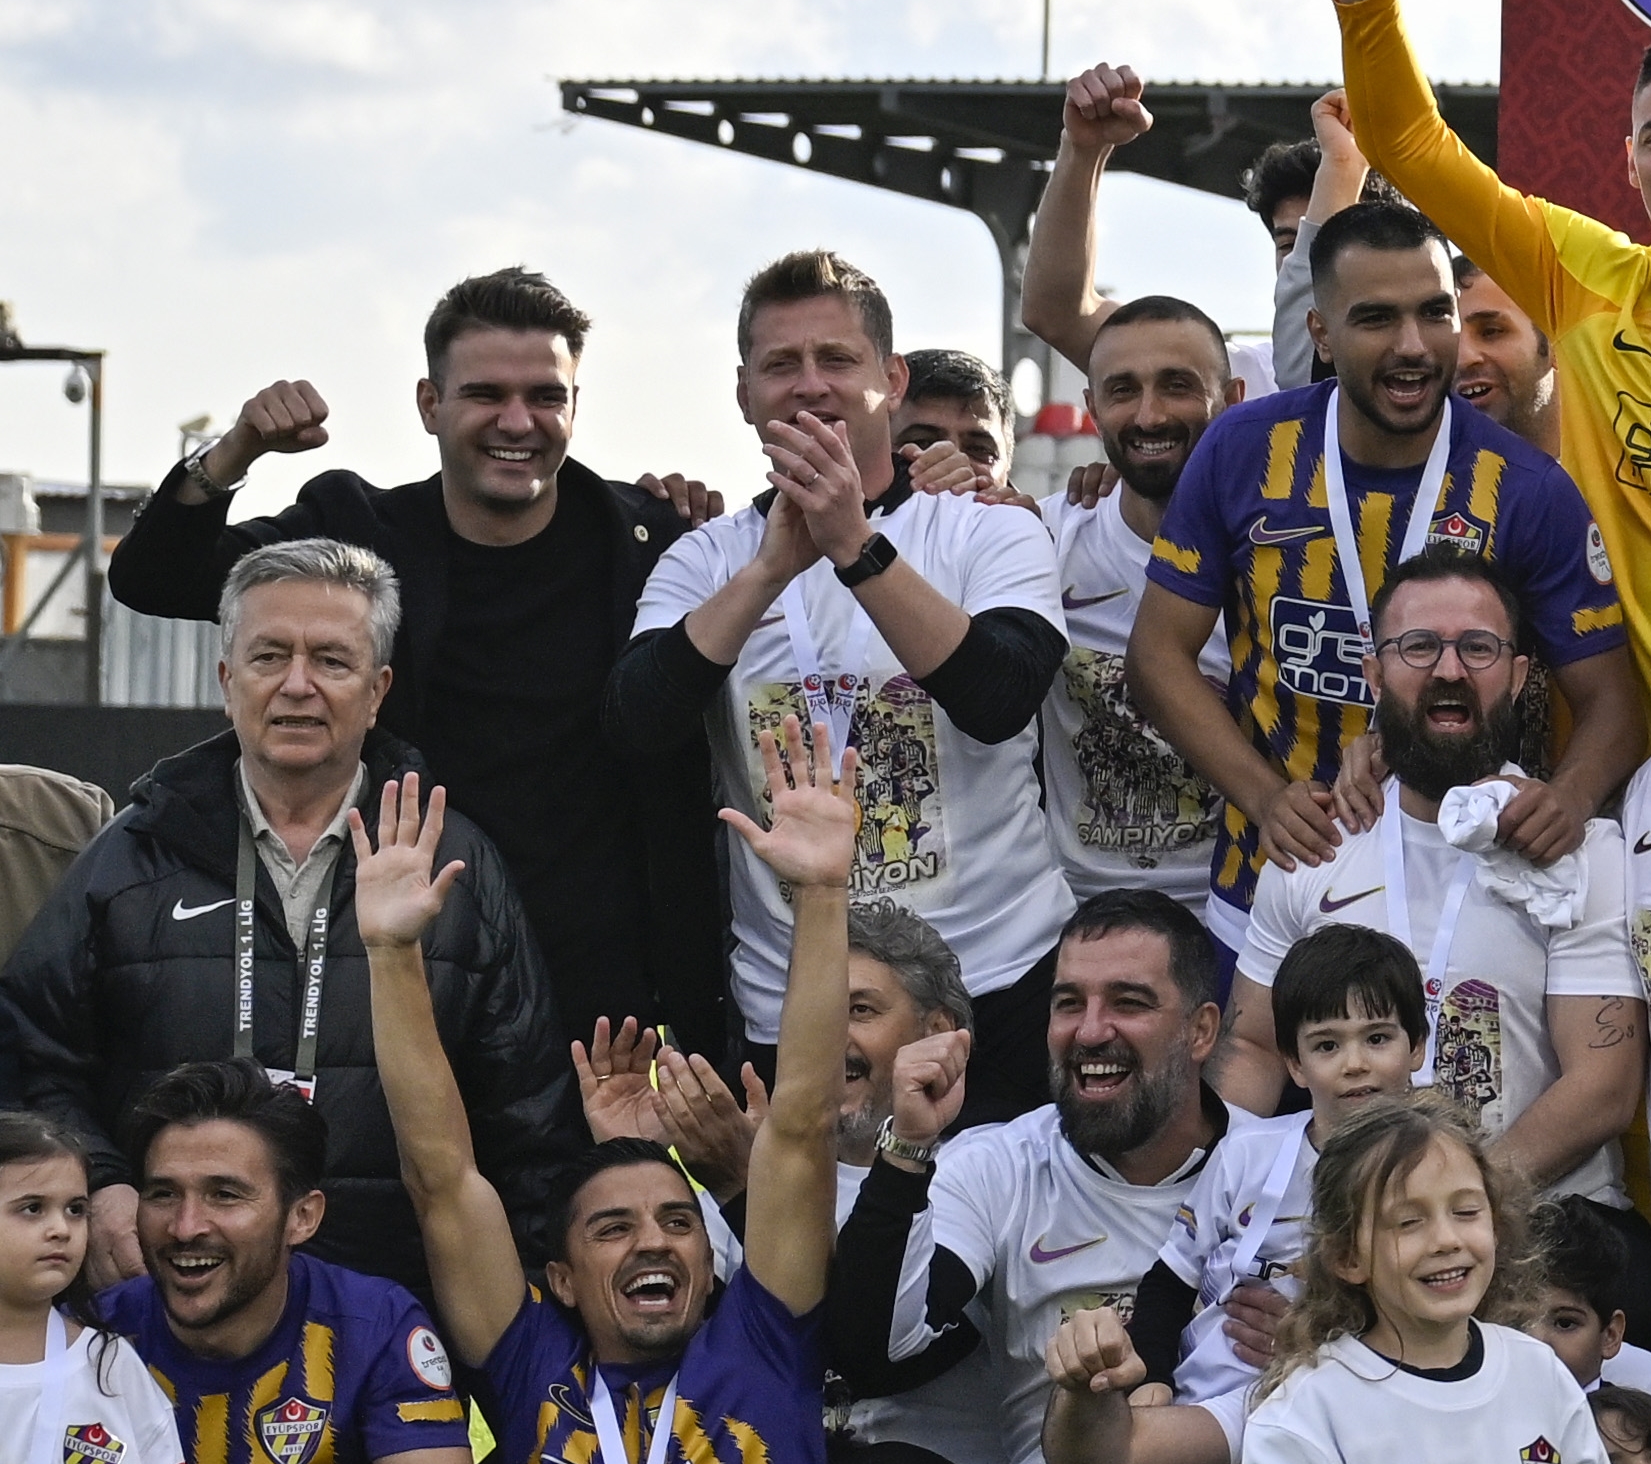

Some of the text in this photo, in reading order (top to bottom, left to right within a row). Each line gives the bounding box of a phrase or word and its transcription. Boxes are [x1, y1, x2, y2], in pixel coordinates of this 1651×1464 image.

[240, 949, 253, 1033] TRENDYOL
[303, 955, 324, 1038] TRENDYOL
[265, 1421, 323, 1437] EYÜPSPOR
